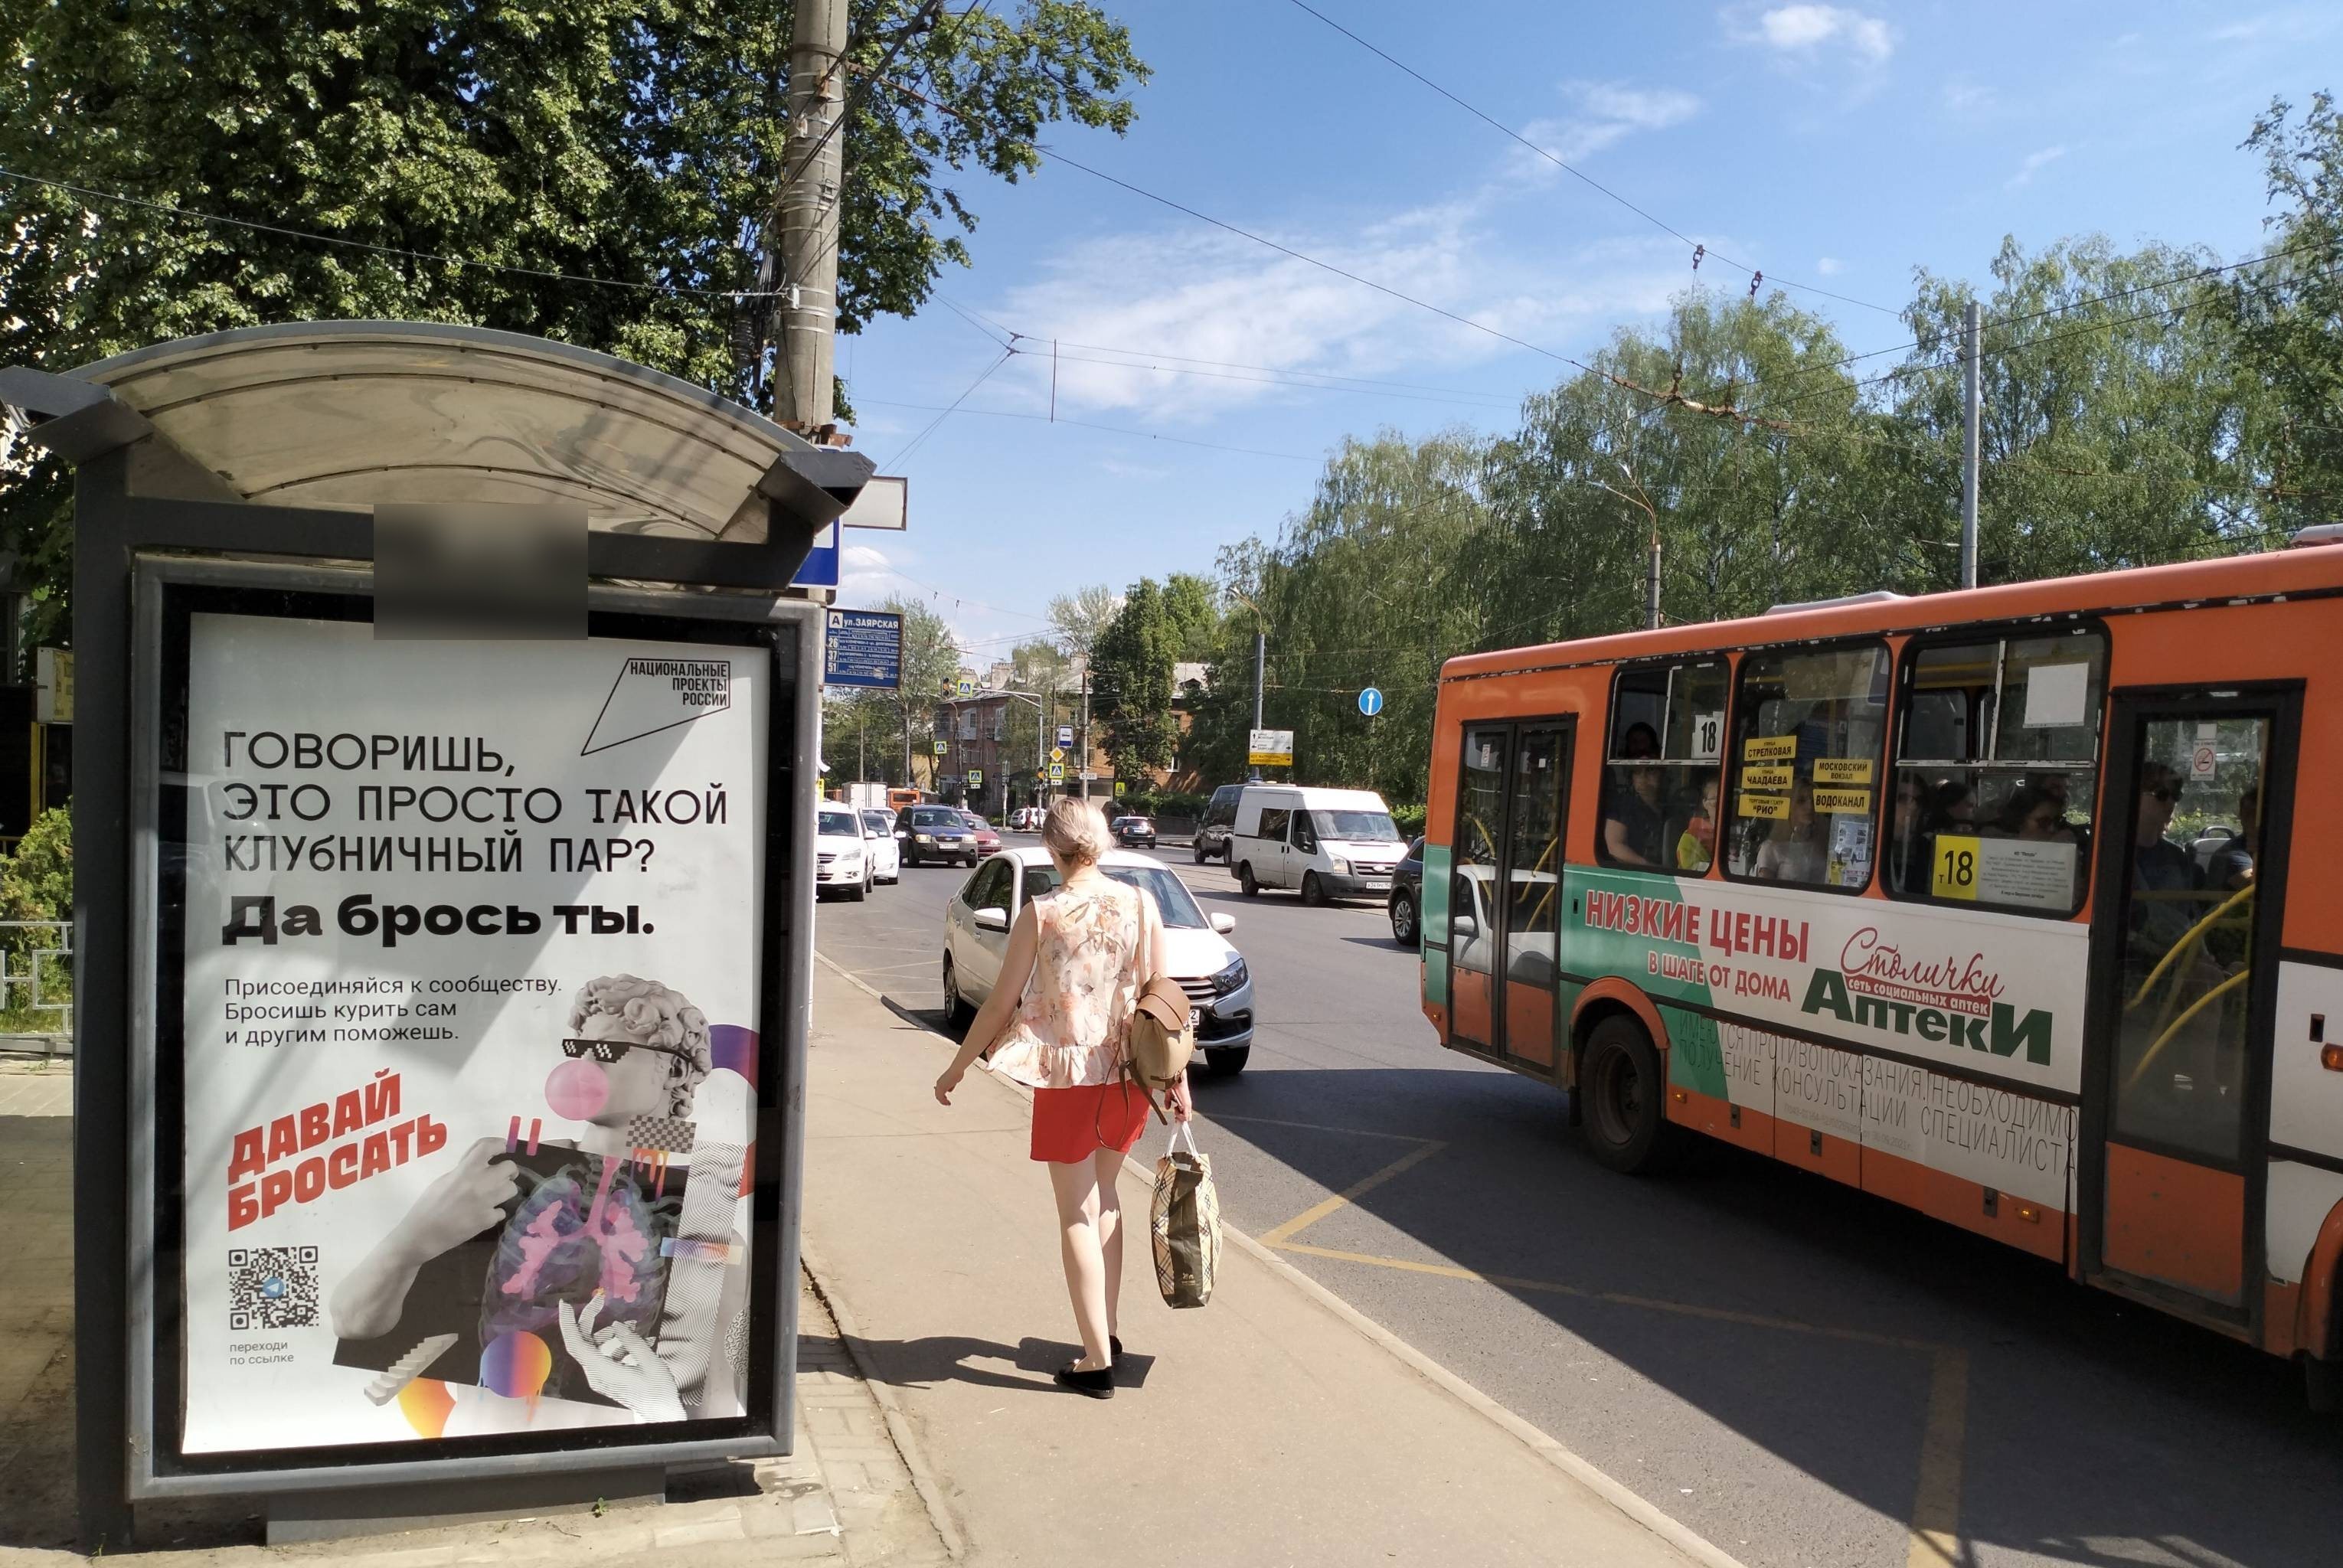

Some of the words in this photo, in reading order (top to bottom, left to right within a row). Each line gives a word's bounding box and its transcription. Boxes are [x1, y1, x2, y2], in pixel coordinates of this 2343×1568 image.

[828, 637, 838, 648] 26
[828, 650, 838, 661] 37
[828, 662, 837, 672] 51
[630, 662, 727, 678] НАЦИОНАЛЬНЫЕ
[672, 678, 727, 691] ПРОЕКТЫ
[682, 692, 727, 707] РОССИИ
[1701, 721, 1717, 753] 18
[224, 731, 515, 777] ГОВОРИШЬ,
[1748, 746, 1792, 758] СТРЕЛКОВАЯ
[1819, 761, 1868, 773] МОСКОВСКИЙ
[1747, 776, 1788, 786] ЧААДАЕВА
[223, 782, 331, 821] ЭТО
[358, 785, 563, 825] ПРОСТО
[585, 782, 727, 825] ТАКОЙ
[1815, 795, 1864, 808] ВОДОКАНАЛ
[550, 838, 655, 873] ПАР?
[222, 895, 323, 946] Да
[337, 893, 541, 948] брось
[553, 905, 655, 935] ты.
[1586, 890, 1701, 945] НИЗКИЕ
[1710, 909, 1809, 963] ЦЕНЫ
[1840, 926, 2005, 998] Столички
[225, 977, 404, 1000] Присоединяйся
[411, 980, 423, 993] к
[429, 975, 563, 996] сообществу.
[1649, 951, 1658, 974] В
[1662, 952, 1704, 985] ШАГЕ
[1709, 965, 1731, 988] ОТ
[1735, 969, 1792, 1003] ДОМА
[1848, 977, 1872, 992] сеть
[1874, 983, 1947, 1010] социальных
[1949, 996, 1989, 1016] аптек
[225, 1003, 327, 1024] Бросишь
[334, 1003, 409, 1023] курить
[415, 1003, 457, 1018] сам
[225, 1031, 238, 1044] и
[245, 1028, 326, 1048] другим
[334, 1027, 459, 1042] поможешь.
[1679, 1039, 1761, 1086] ПОЛУЧЕНИЕ
[1772, 1064, 1907, 1129] КОНСУЛЬТАЦИИ
[1920, 1106, 2077, 1180] СПЕЦИАЛИСТА
[1932, 1073, 2078, 1142] НЕОБХОДИМО
[227, 1067, 400, 1186] ДАВАЙ
[227, 1113, 448, 1233] БРОСАТЬ
[230, 1341, 288, 1354] переходи
[230, 1357, 245, 1366] по
[248, 1354, 295, 1365] ссылке
